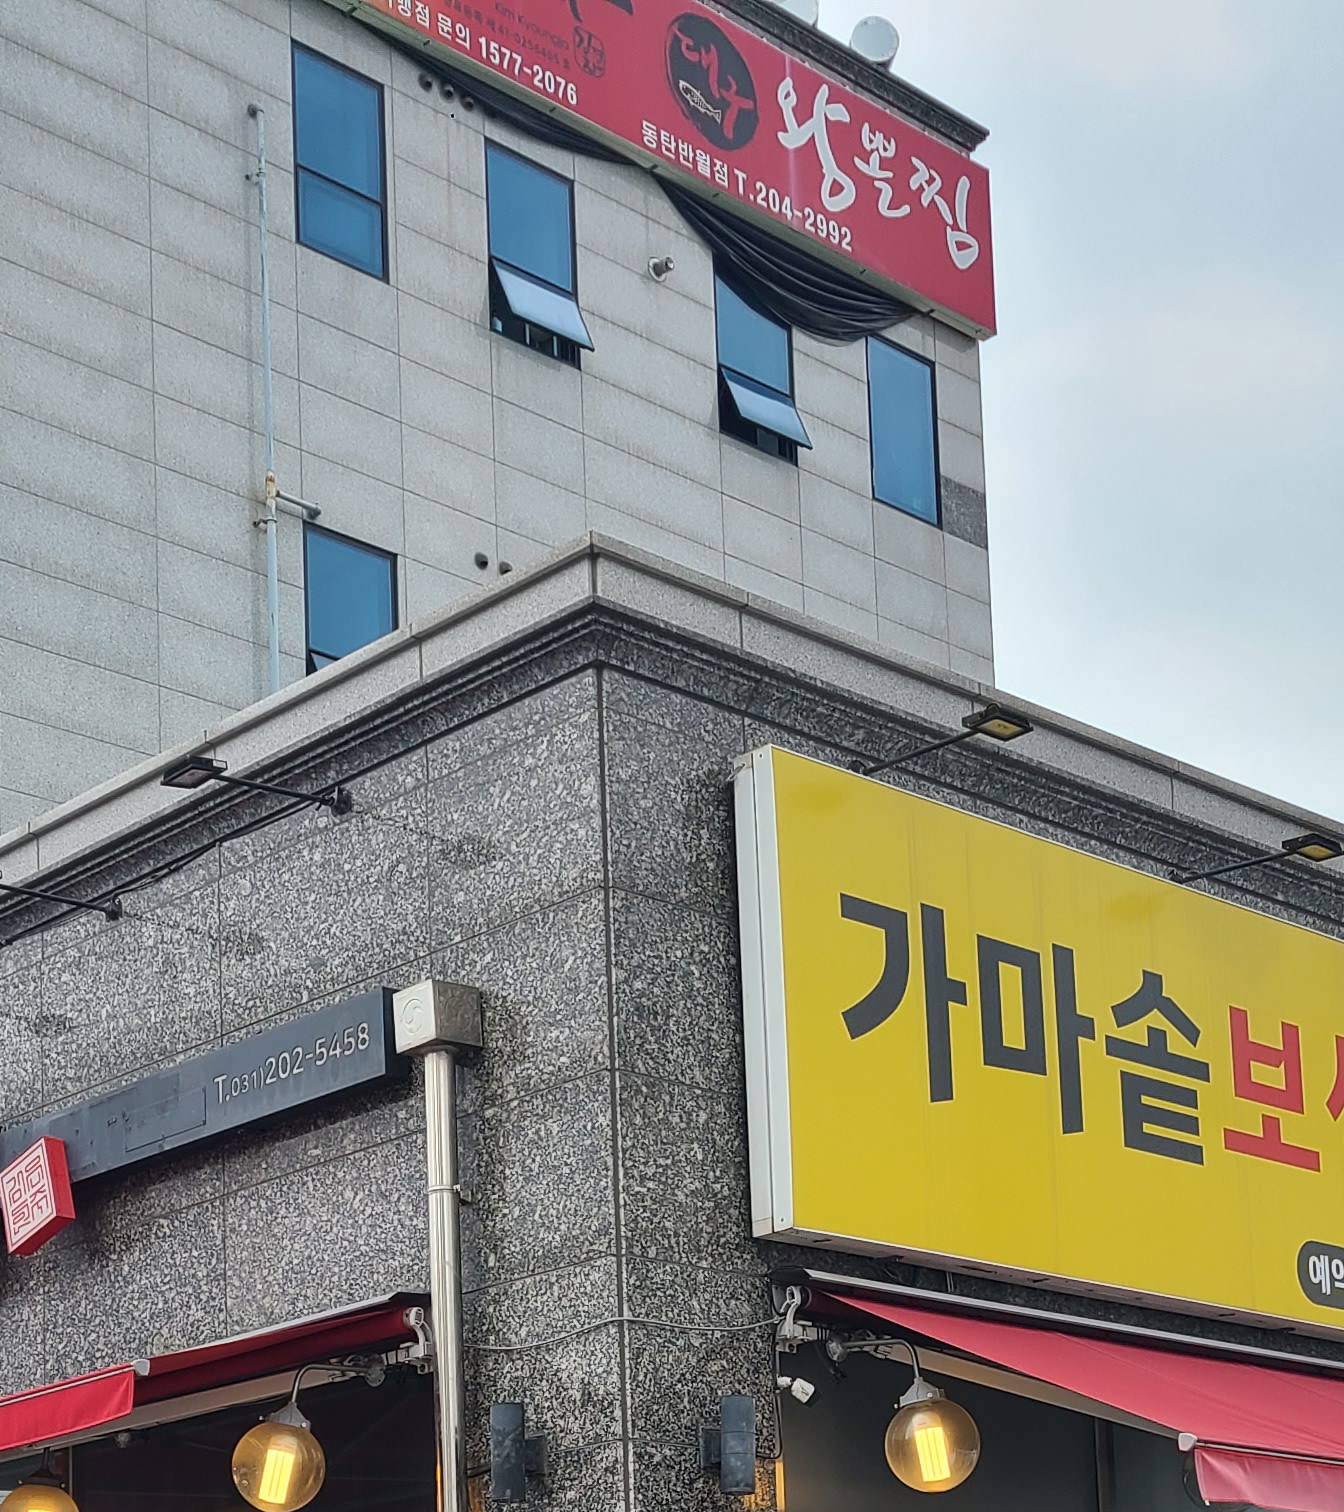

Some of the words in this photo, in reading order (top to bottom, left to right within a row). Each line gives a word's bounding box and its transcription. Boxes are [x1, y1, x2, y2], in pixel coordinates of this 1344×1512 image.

[387, 0, 430, 29] 맹점
[437, 12, 471, 50] 문의
[479, 36, 577, 105] 1577-2076
[641, 119, 729, 185] 동탄반월점
